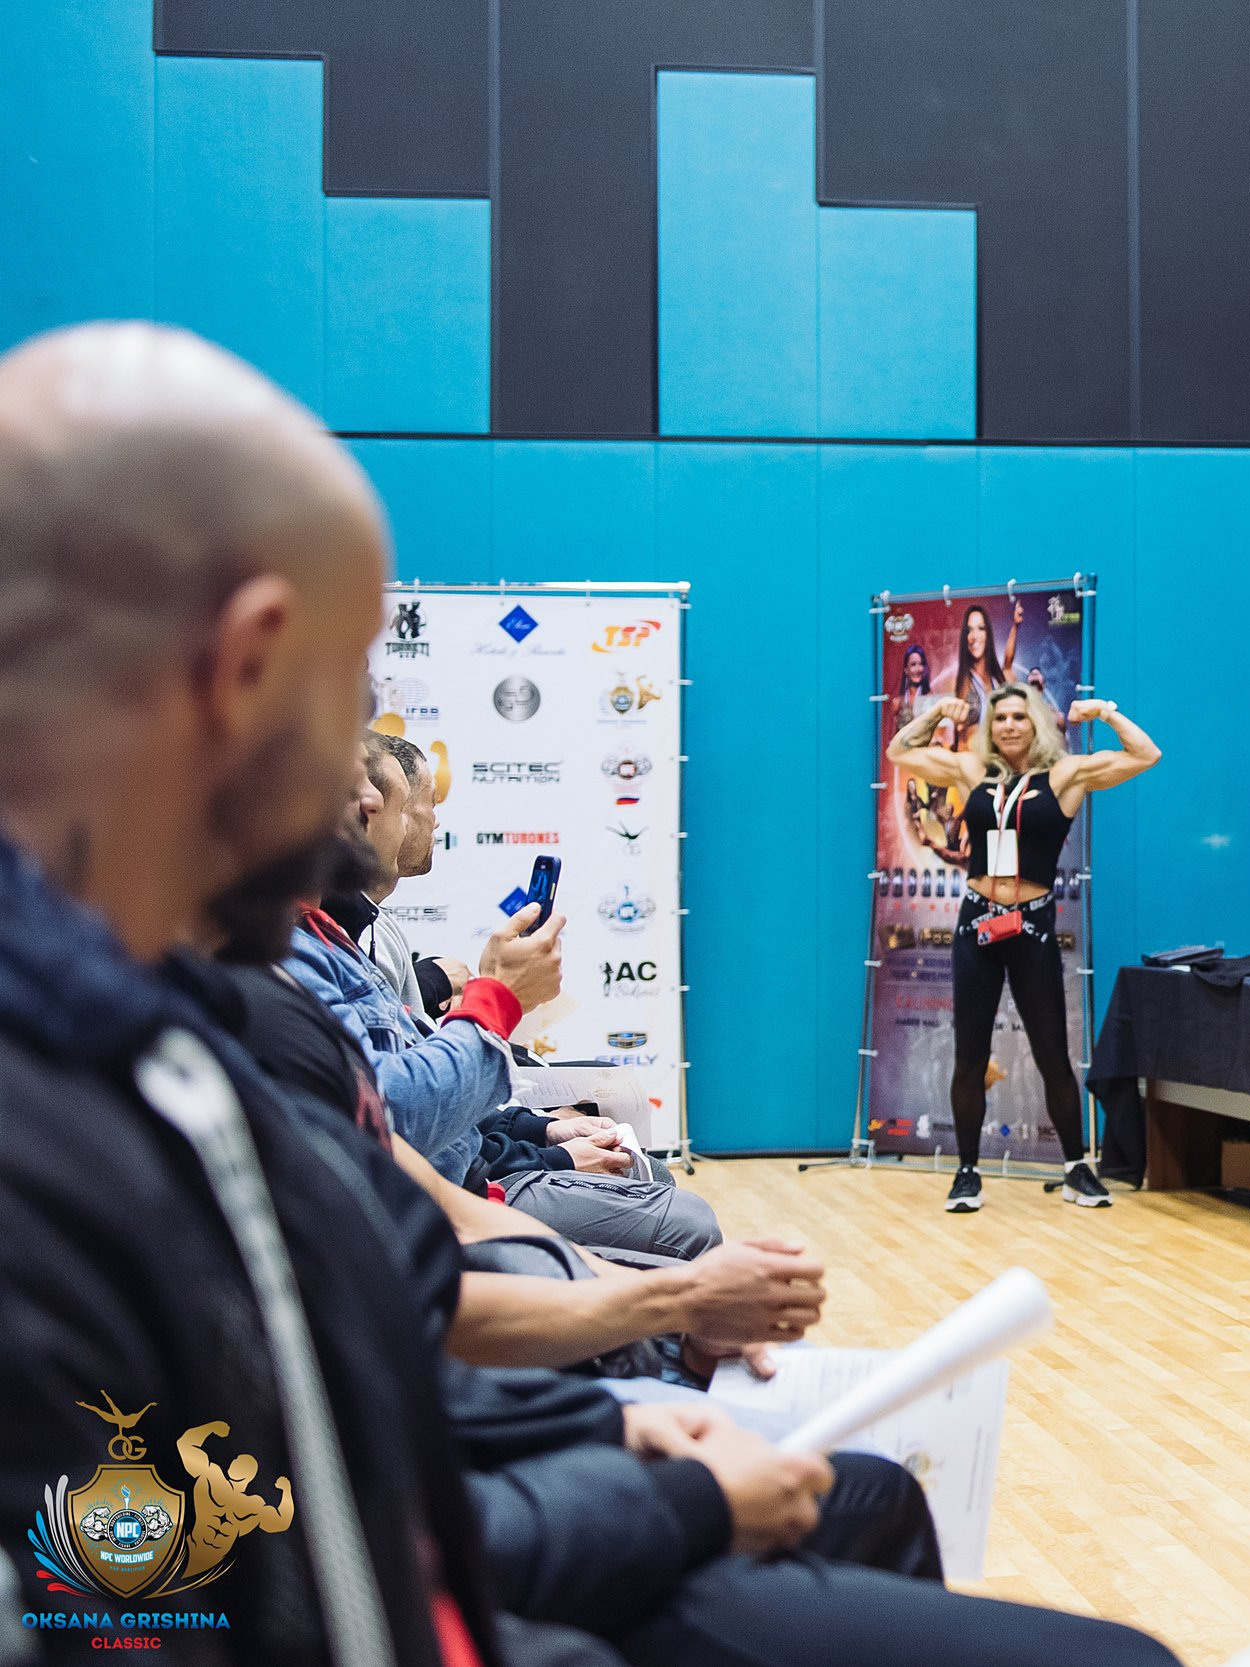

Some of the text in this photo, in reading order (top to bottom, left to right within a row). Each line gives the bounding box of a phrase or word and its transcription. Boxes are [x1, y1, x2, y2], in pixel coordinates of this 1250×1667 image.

[604, 625, 650, 647] TSP
[473, 761, 564, 773] SCITEC
[472, 774, 560, 784] NUTRITION
[389, 905, 449, 914] CITEC
[615, 961, 657, 981] AC
